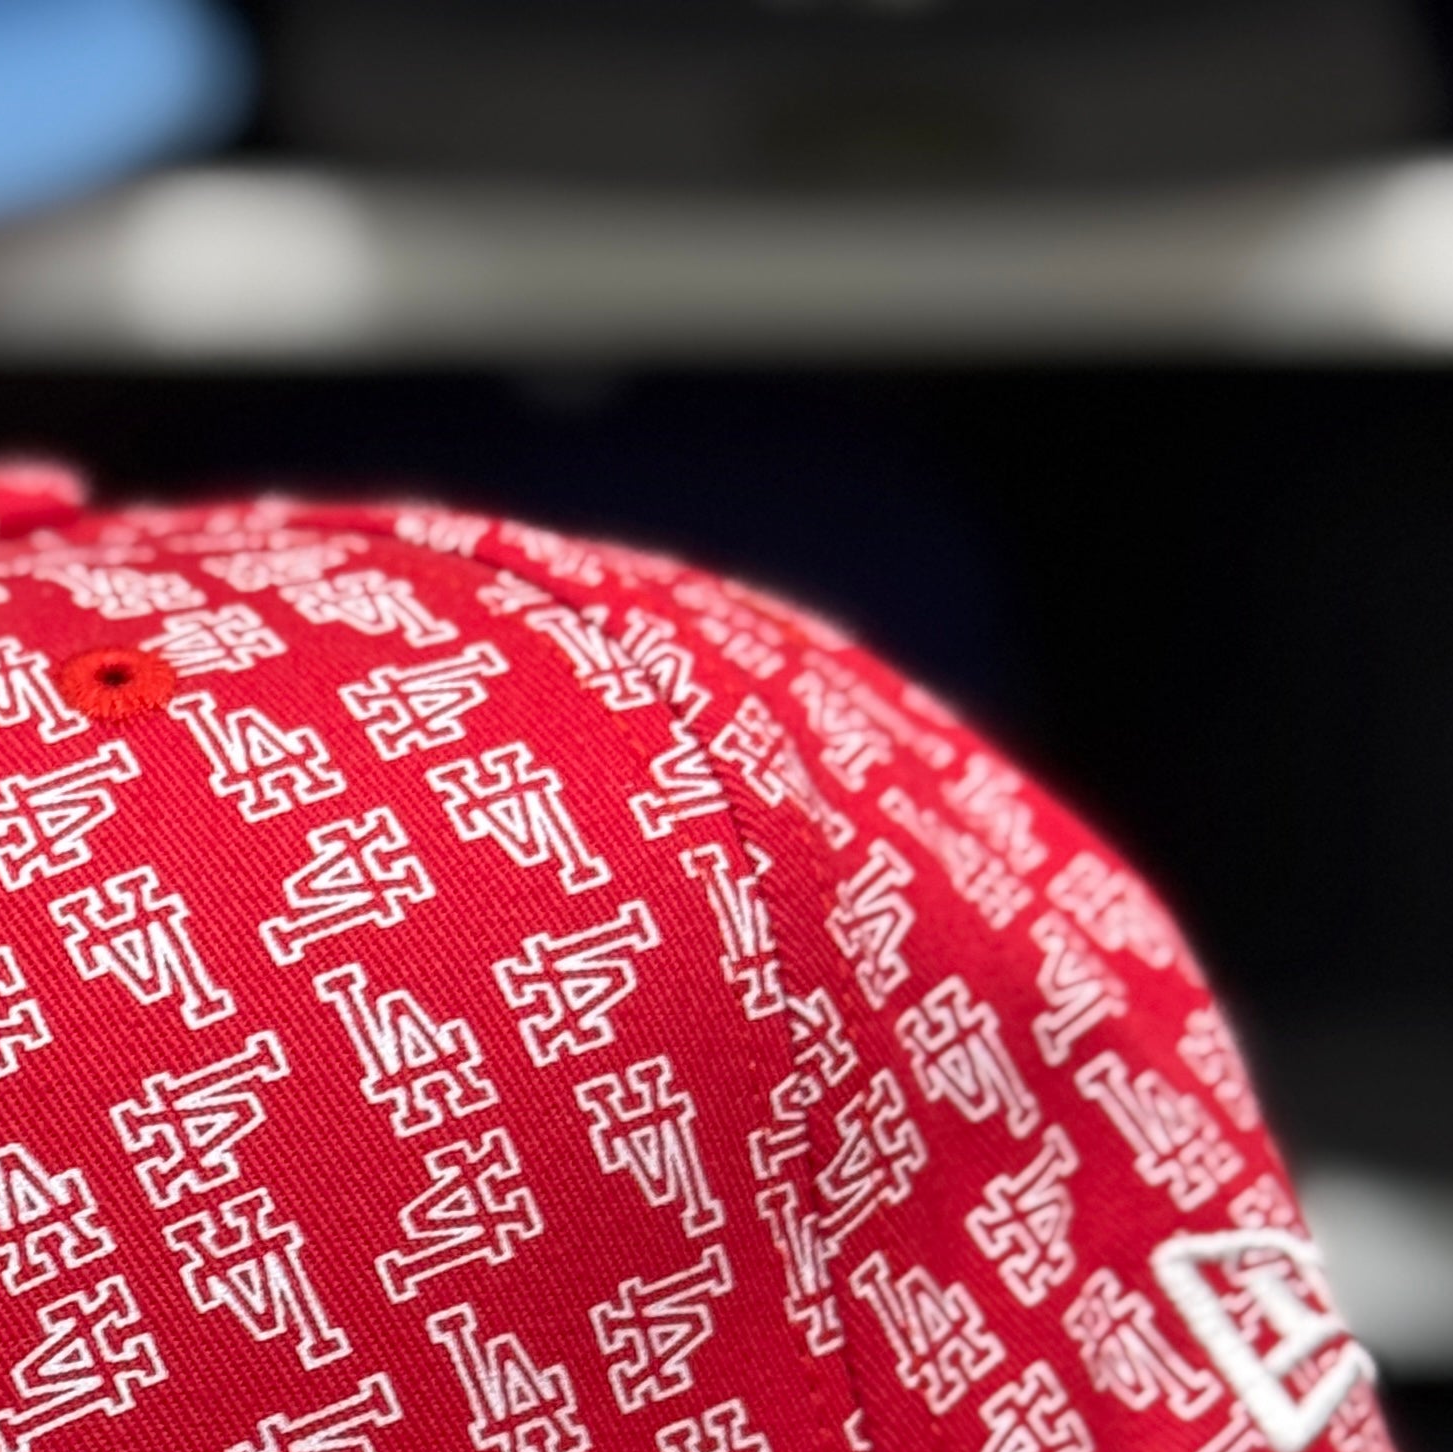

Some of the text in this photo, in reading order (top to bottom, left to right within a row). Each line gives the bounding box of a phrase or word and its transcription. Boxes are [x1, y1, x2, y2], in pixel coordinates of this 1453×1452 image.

[168, 691, 347, 823] LA
[340, 642, 509, 761] LA
[259, 807, 436, 966] LA
[426, 742, 611, 894] LA
[49, 866, 237, 1030] LA
[492, 900, 661, 1067] LA
[110, 1031, 290, 1209] LA
[313, 964, 499, 1137] LA
[894, 975, 1041, 1139] LA
[1073, 1050, 1244, 1211] LA
[374, 1127, 545, 1303] LA
[575, 1055, 726, 1238] LA
[965, 1124, 1079, 1307] LA
[162, 1187, 352, 1370] LA
[589, 1244, 733, 1415] LA
[850, 1251, 1006, 1416] LA
